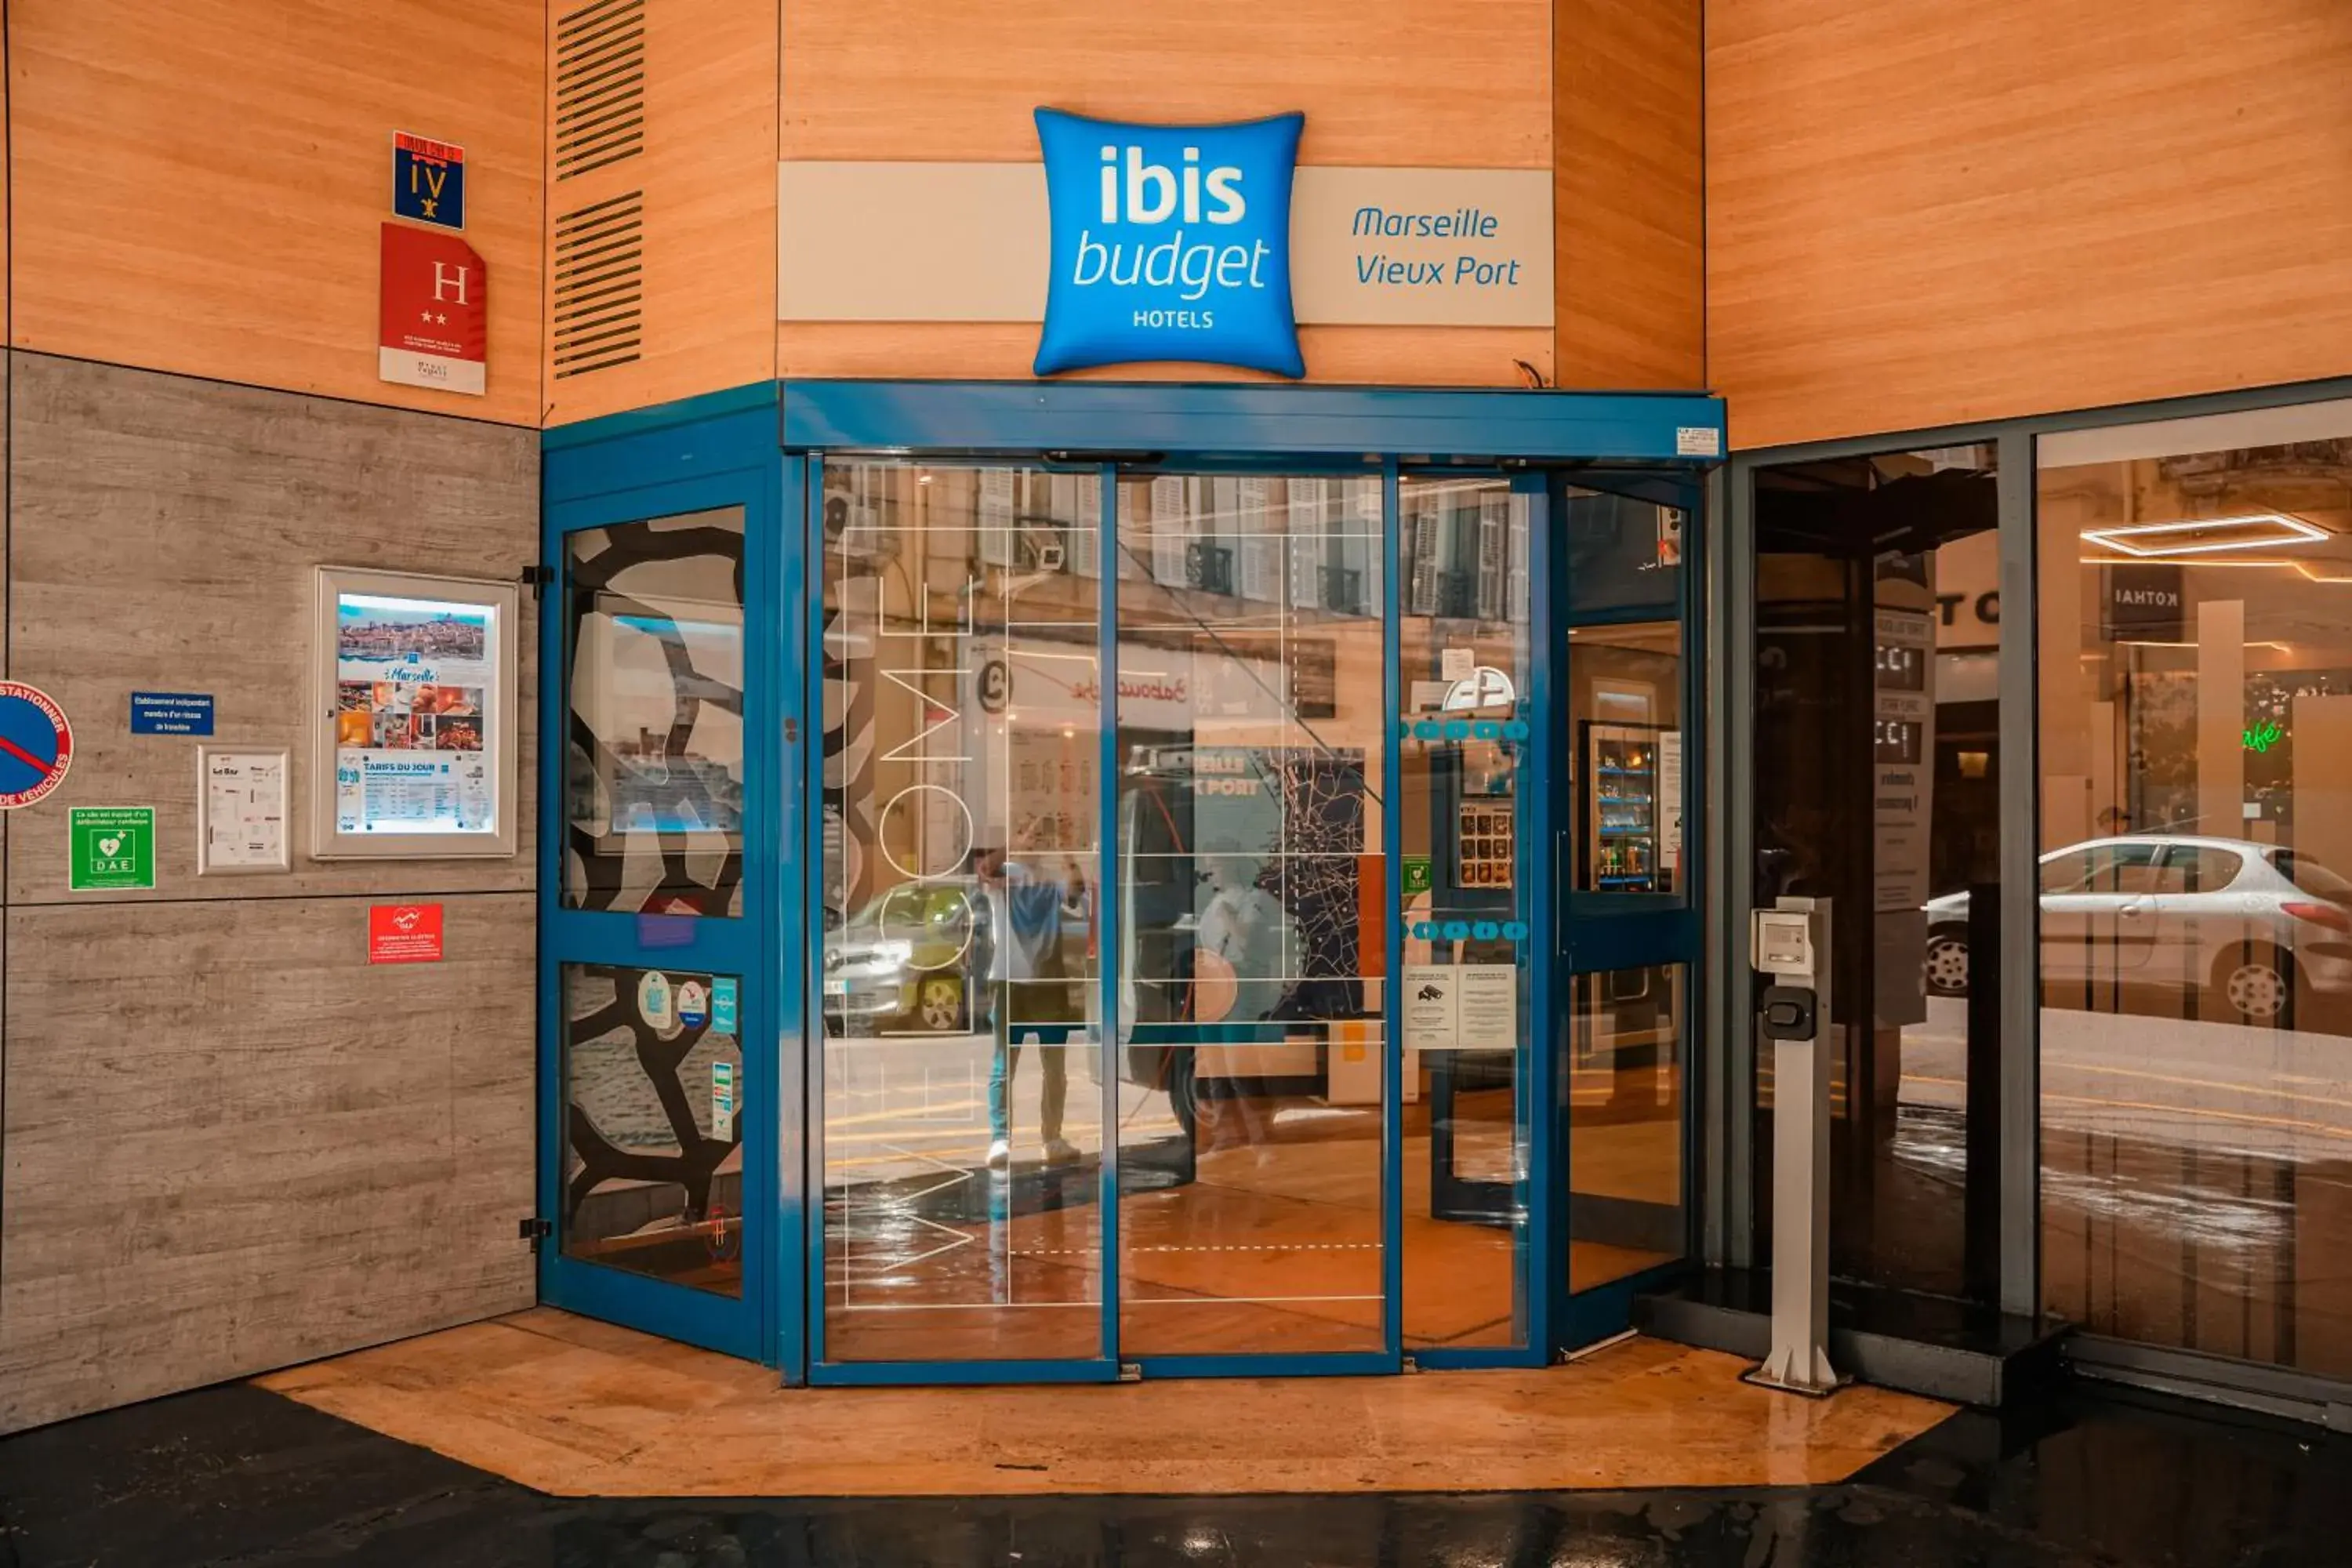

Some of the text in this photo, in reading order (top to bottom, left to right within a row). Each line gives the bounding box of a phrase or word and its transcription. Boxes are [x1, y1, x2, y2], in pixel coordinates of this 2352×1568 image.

[1100, 145, 1247, 225] ibis
[1352, 207, 1497, 238] Marseille
[432, 261, 469, 305] H
[1073, 230, 1269, 299] budget
[1356, 255, 1520, 285] Vieux Port
[1133, 310, 1214, 329] HOTELS
[0, 686, 65, 733] STATIONNER
[17, 753, 68, 803] VEHICULES
[364, 763, 435, 772] TARIFS DU JOUR
[1207, 779, 1259, 795] PORT
[96, 860, 129, 871] DAE
[879, 573, 975, 1273] WELCOME
